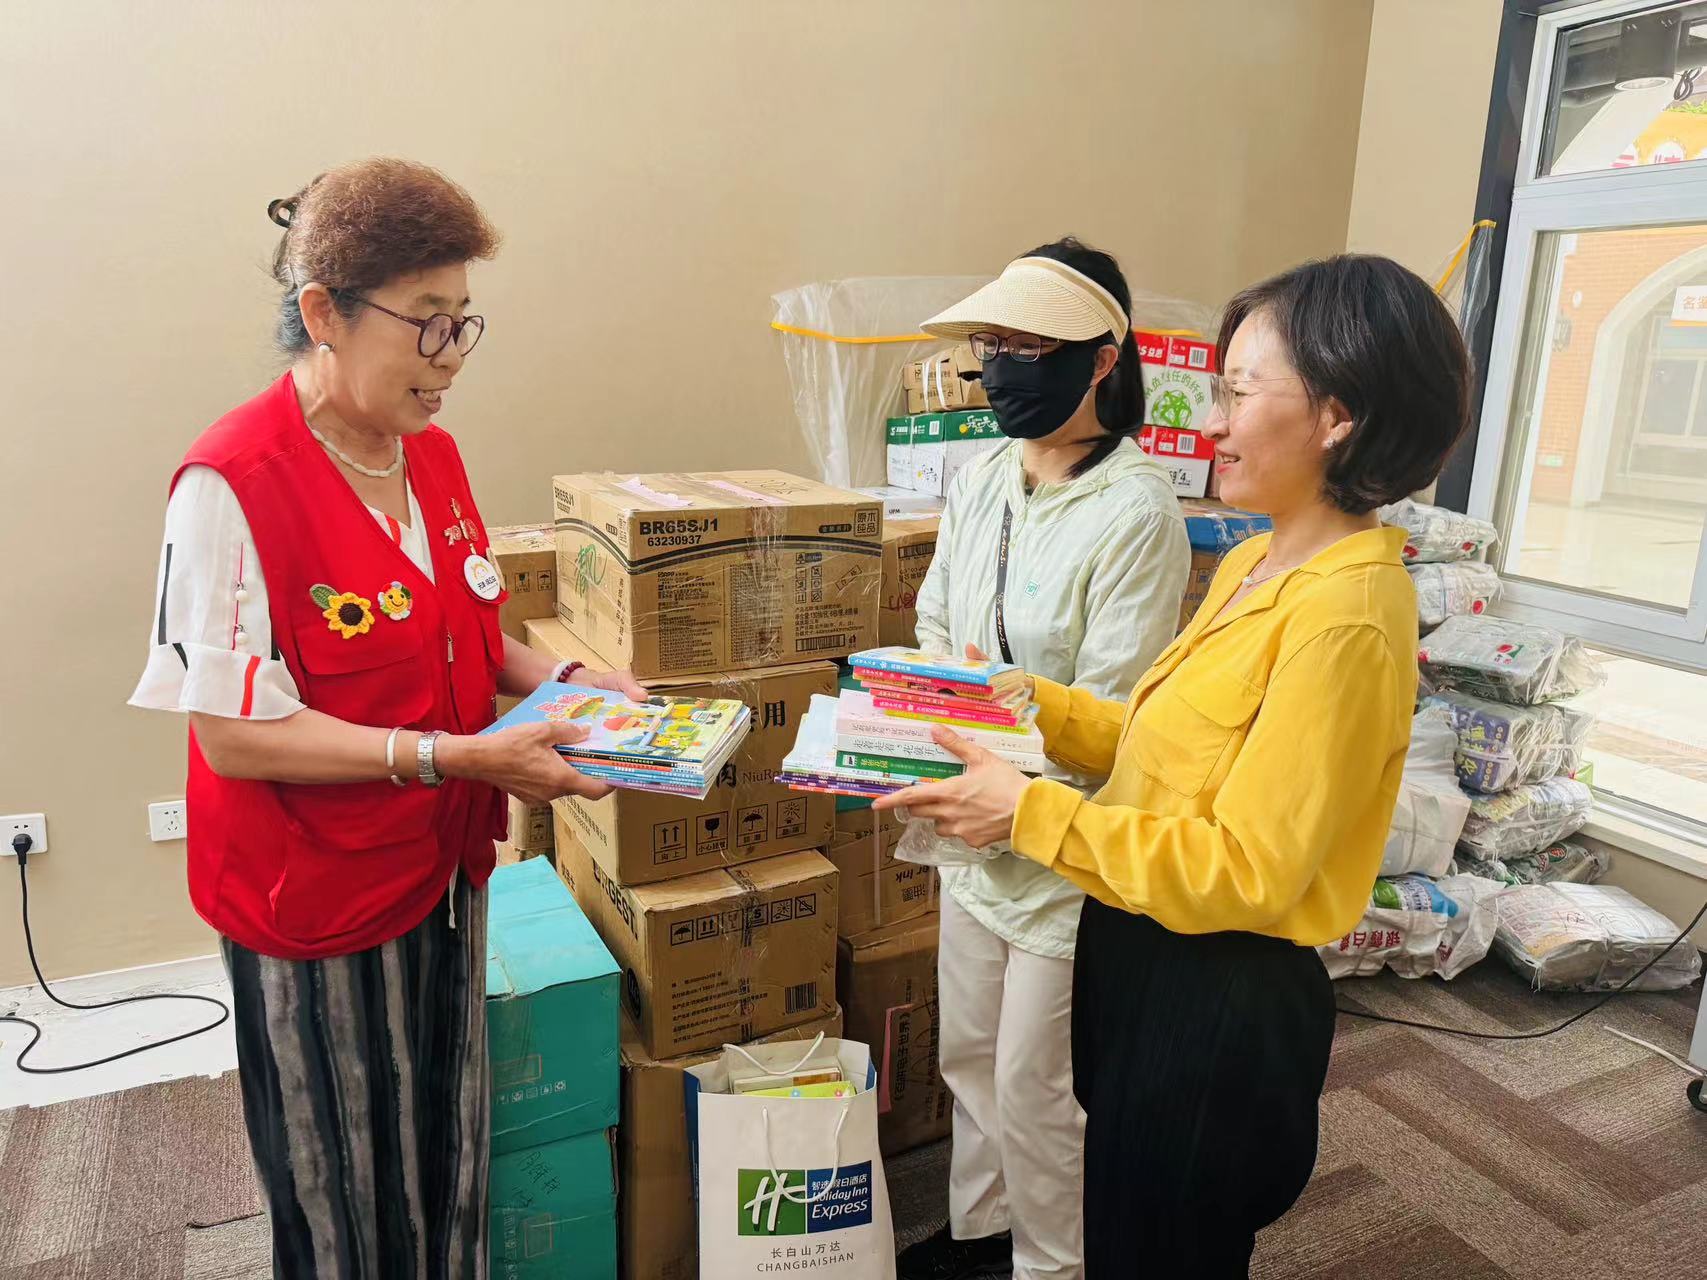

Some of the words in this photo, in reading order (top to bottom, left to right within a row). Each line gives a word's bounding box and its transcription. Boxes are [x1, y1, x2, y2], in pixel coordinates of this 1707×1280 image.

[640, 518, 718, 535] BR65SJ1
[648, 535, 701, 546] 63230937
[852, 1187, 868, 1199] Inn
[812, 1200, 868, 1220] Express
[771, 1241, 840, 1259] 长白山万达
[757, 1252, 854, 1272] CHANGBAISHAN
